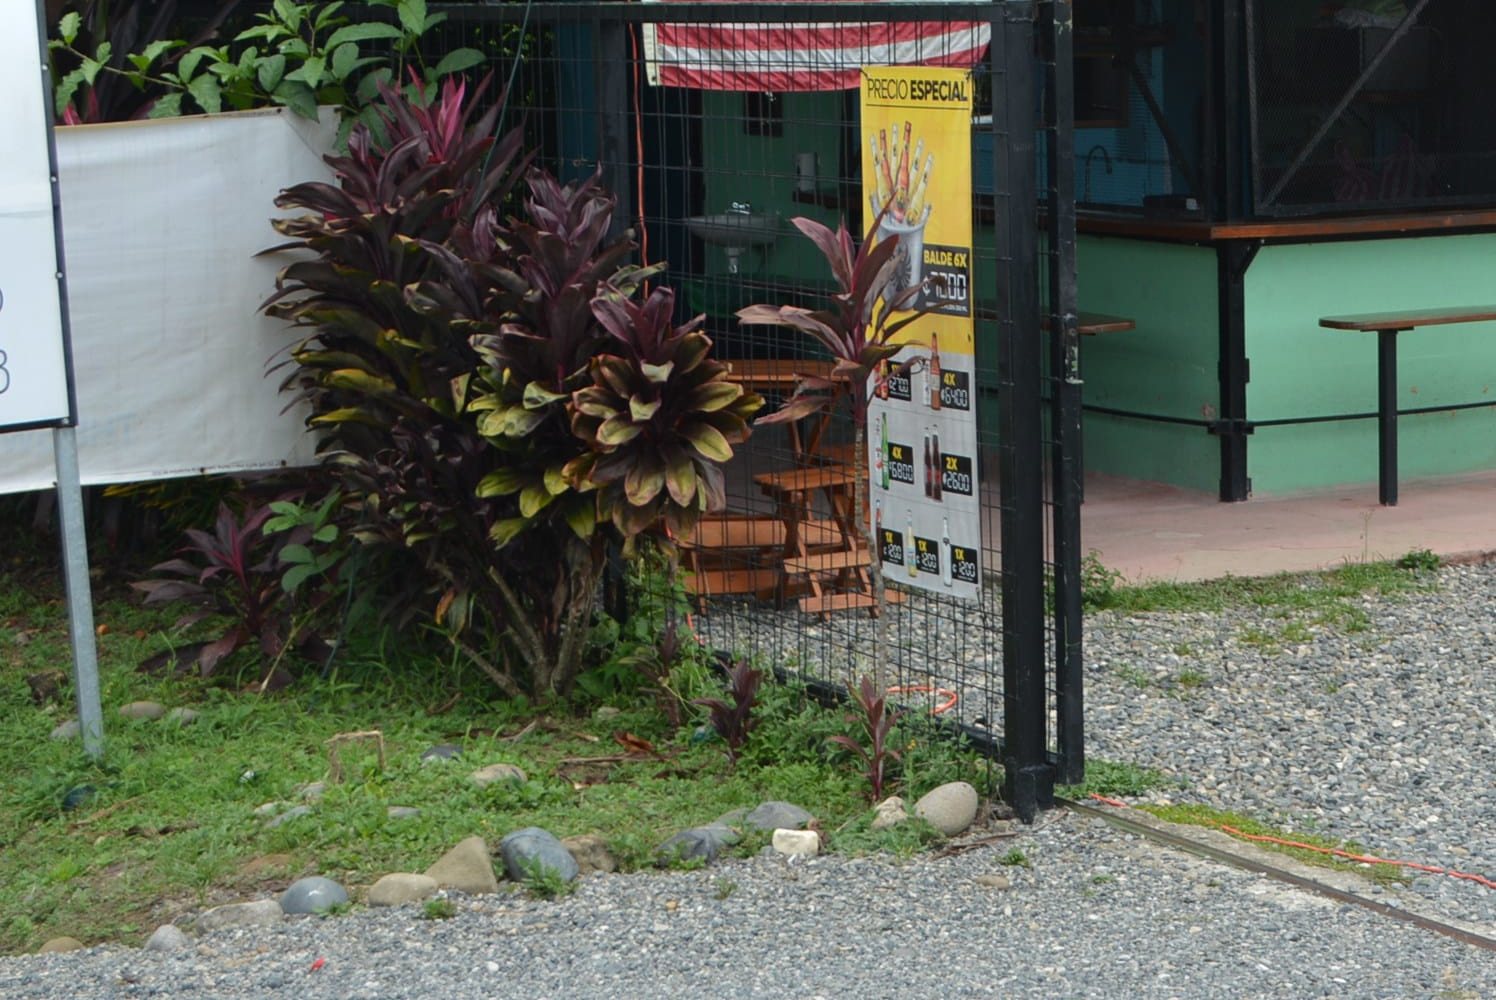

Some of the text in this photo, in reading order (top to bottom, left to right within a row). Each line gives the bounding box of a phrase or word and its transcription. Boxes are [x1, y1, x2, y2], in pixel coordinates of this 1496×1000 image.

[867, 77, 968, 102] PRECIO ESPECIAL
[923, 249, 953, 266] BALDE
